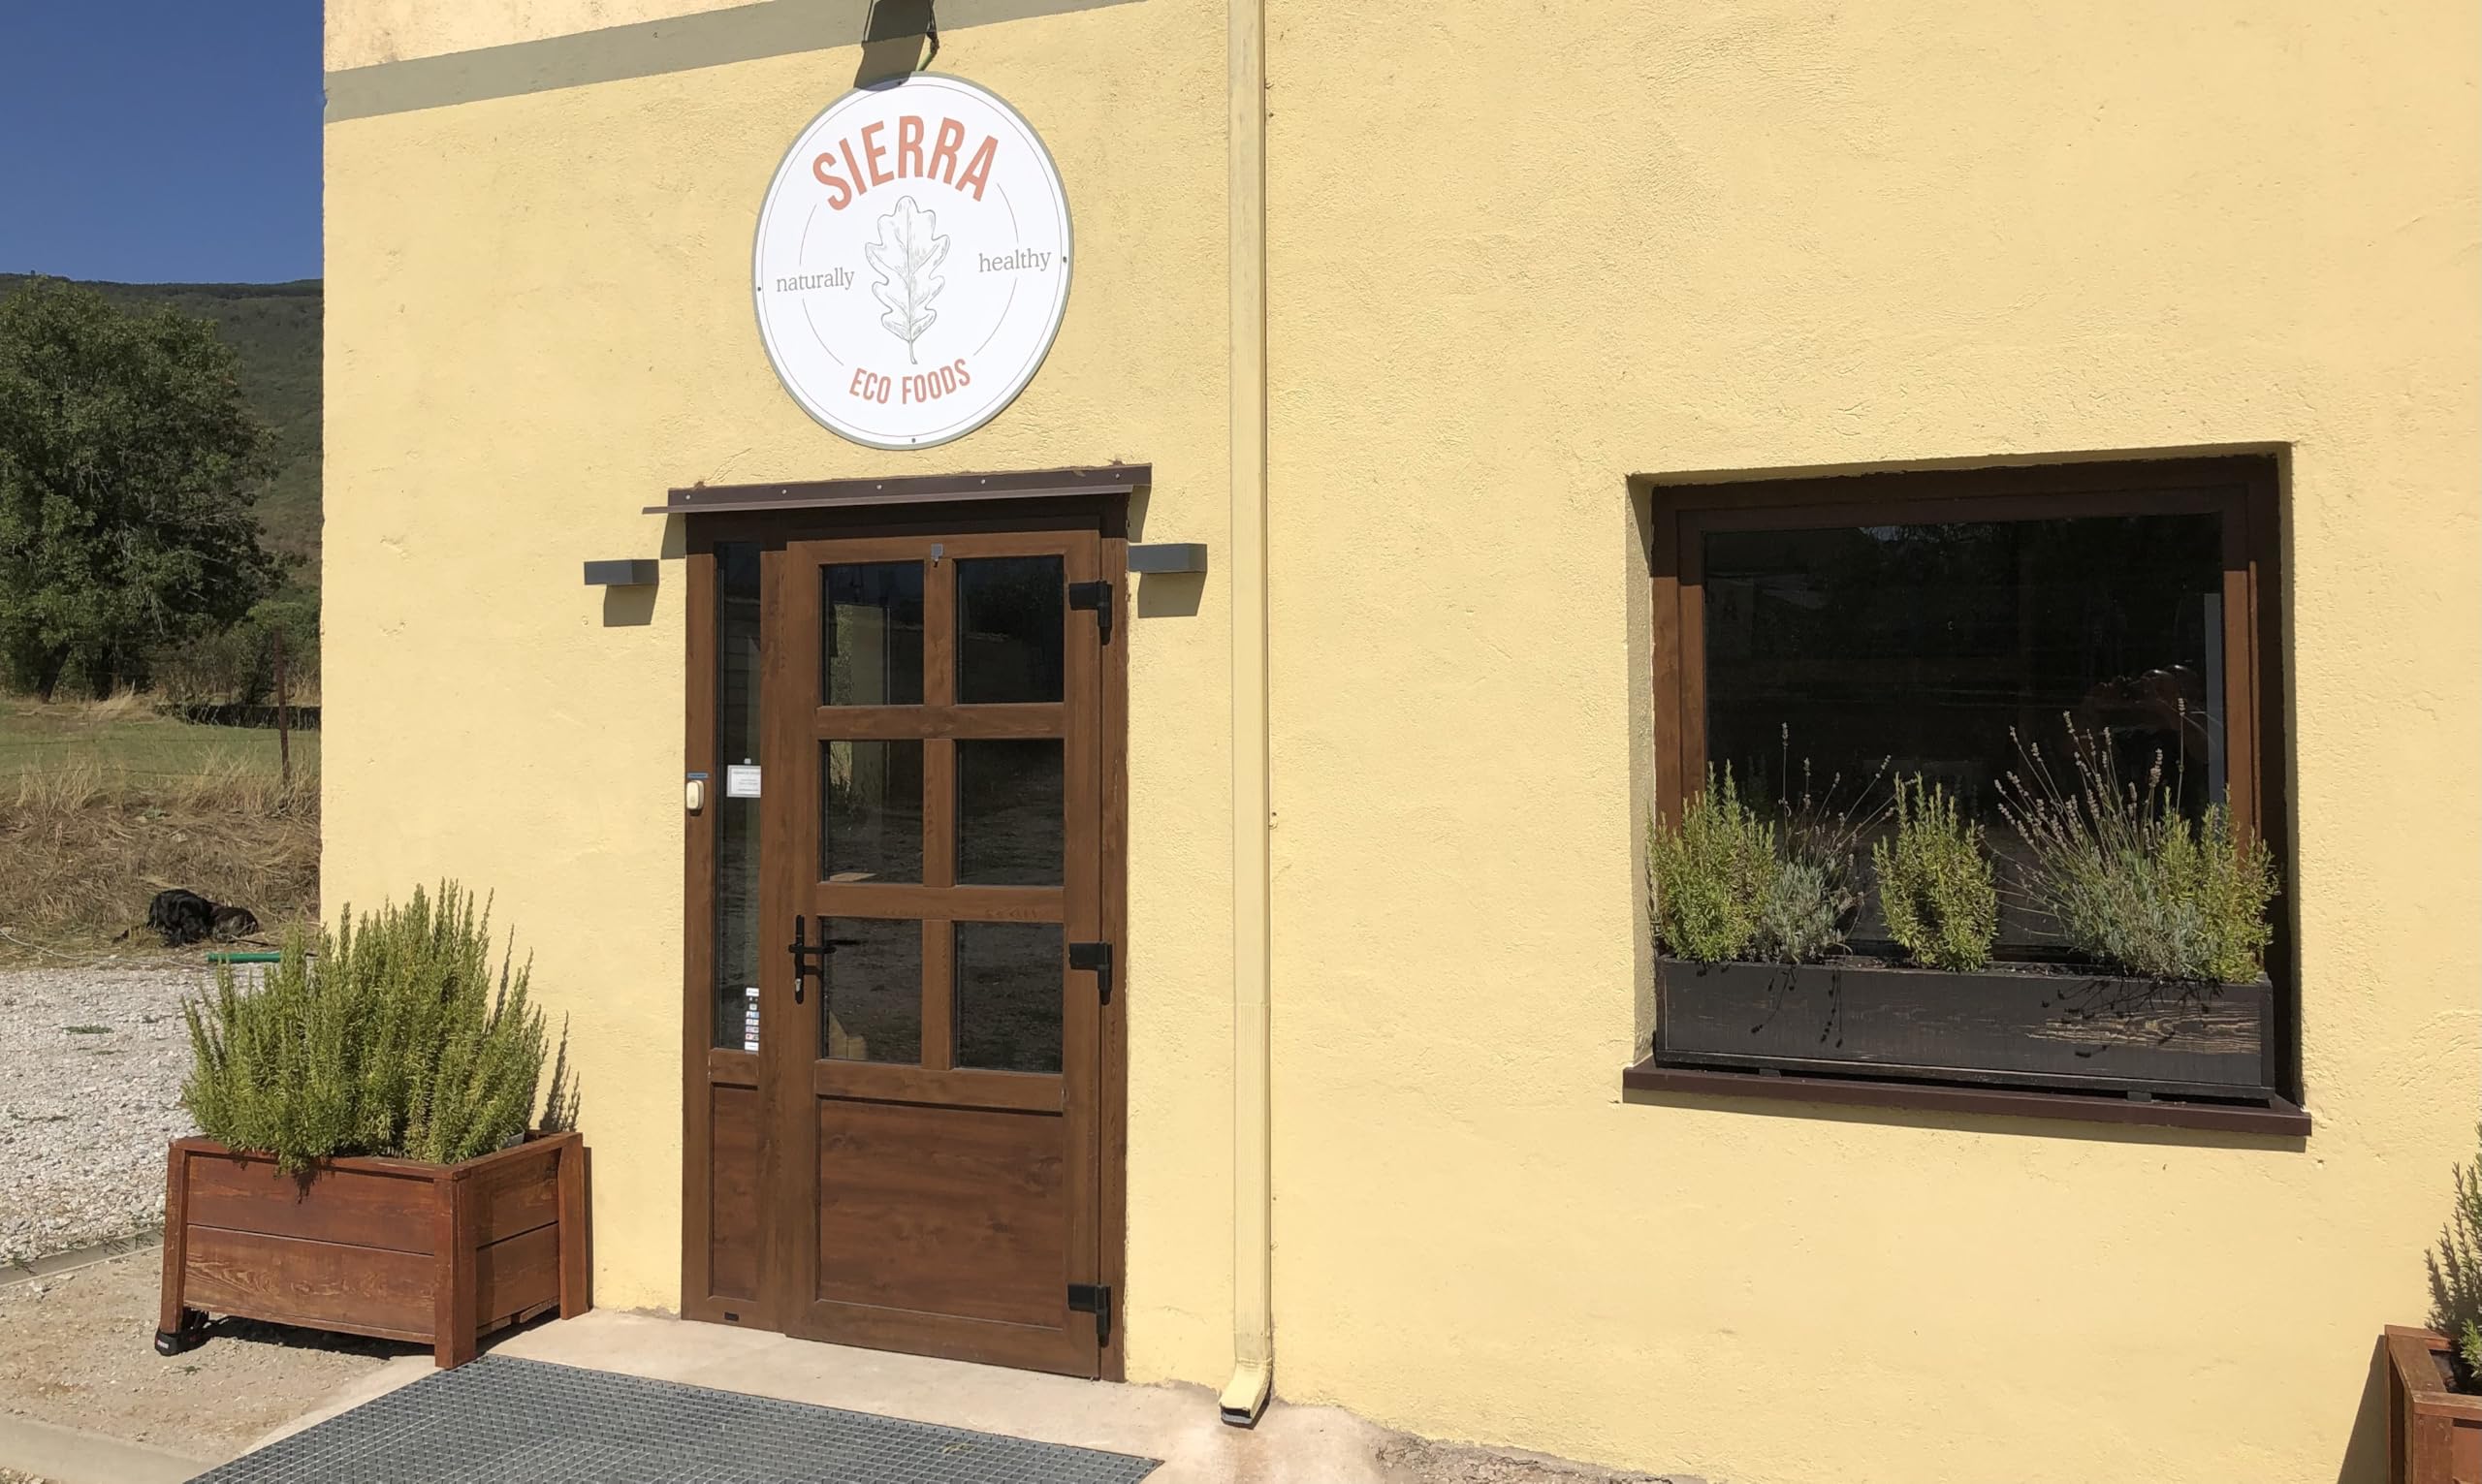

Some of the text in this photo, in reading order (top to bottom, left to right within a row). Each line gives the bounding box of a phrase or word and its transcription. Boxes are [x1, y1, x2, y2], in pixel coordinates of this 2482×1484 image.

[812, 115, 999, 211] SIERRA
[978, 247, 1052, 272] healthy
[776, 267, 855, 293] naturally
[849, 359, 971, 404] ECO FOODS
